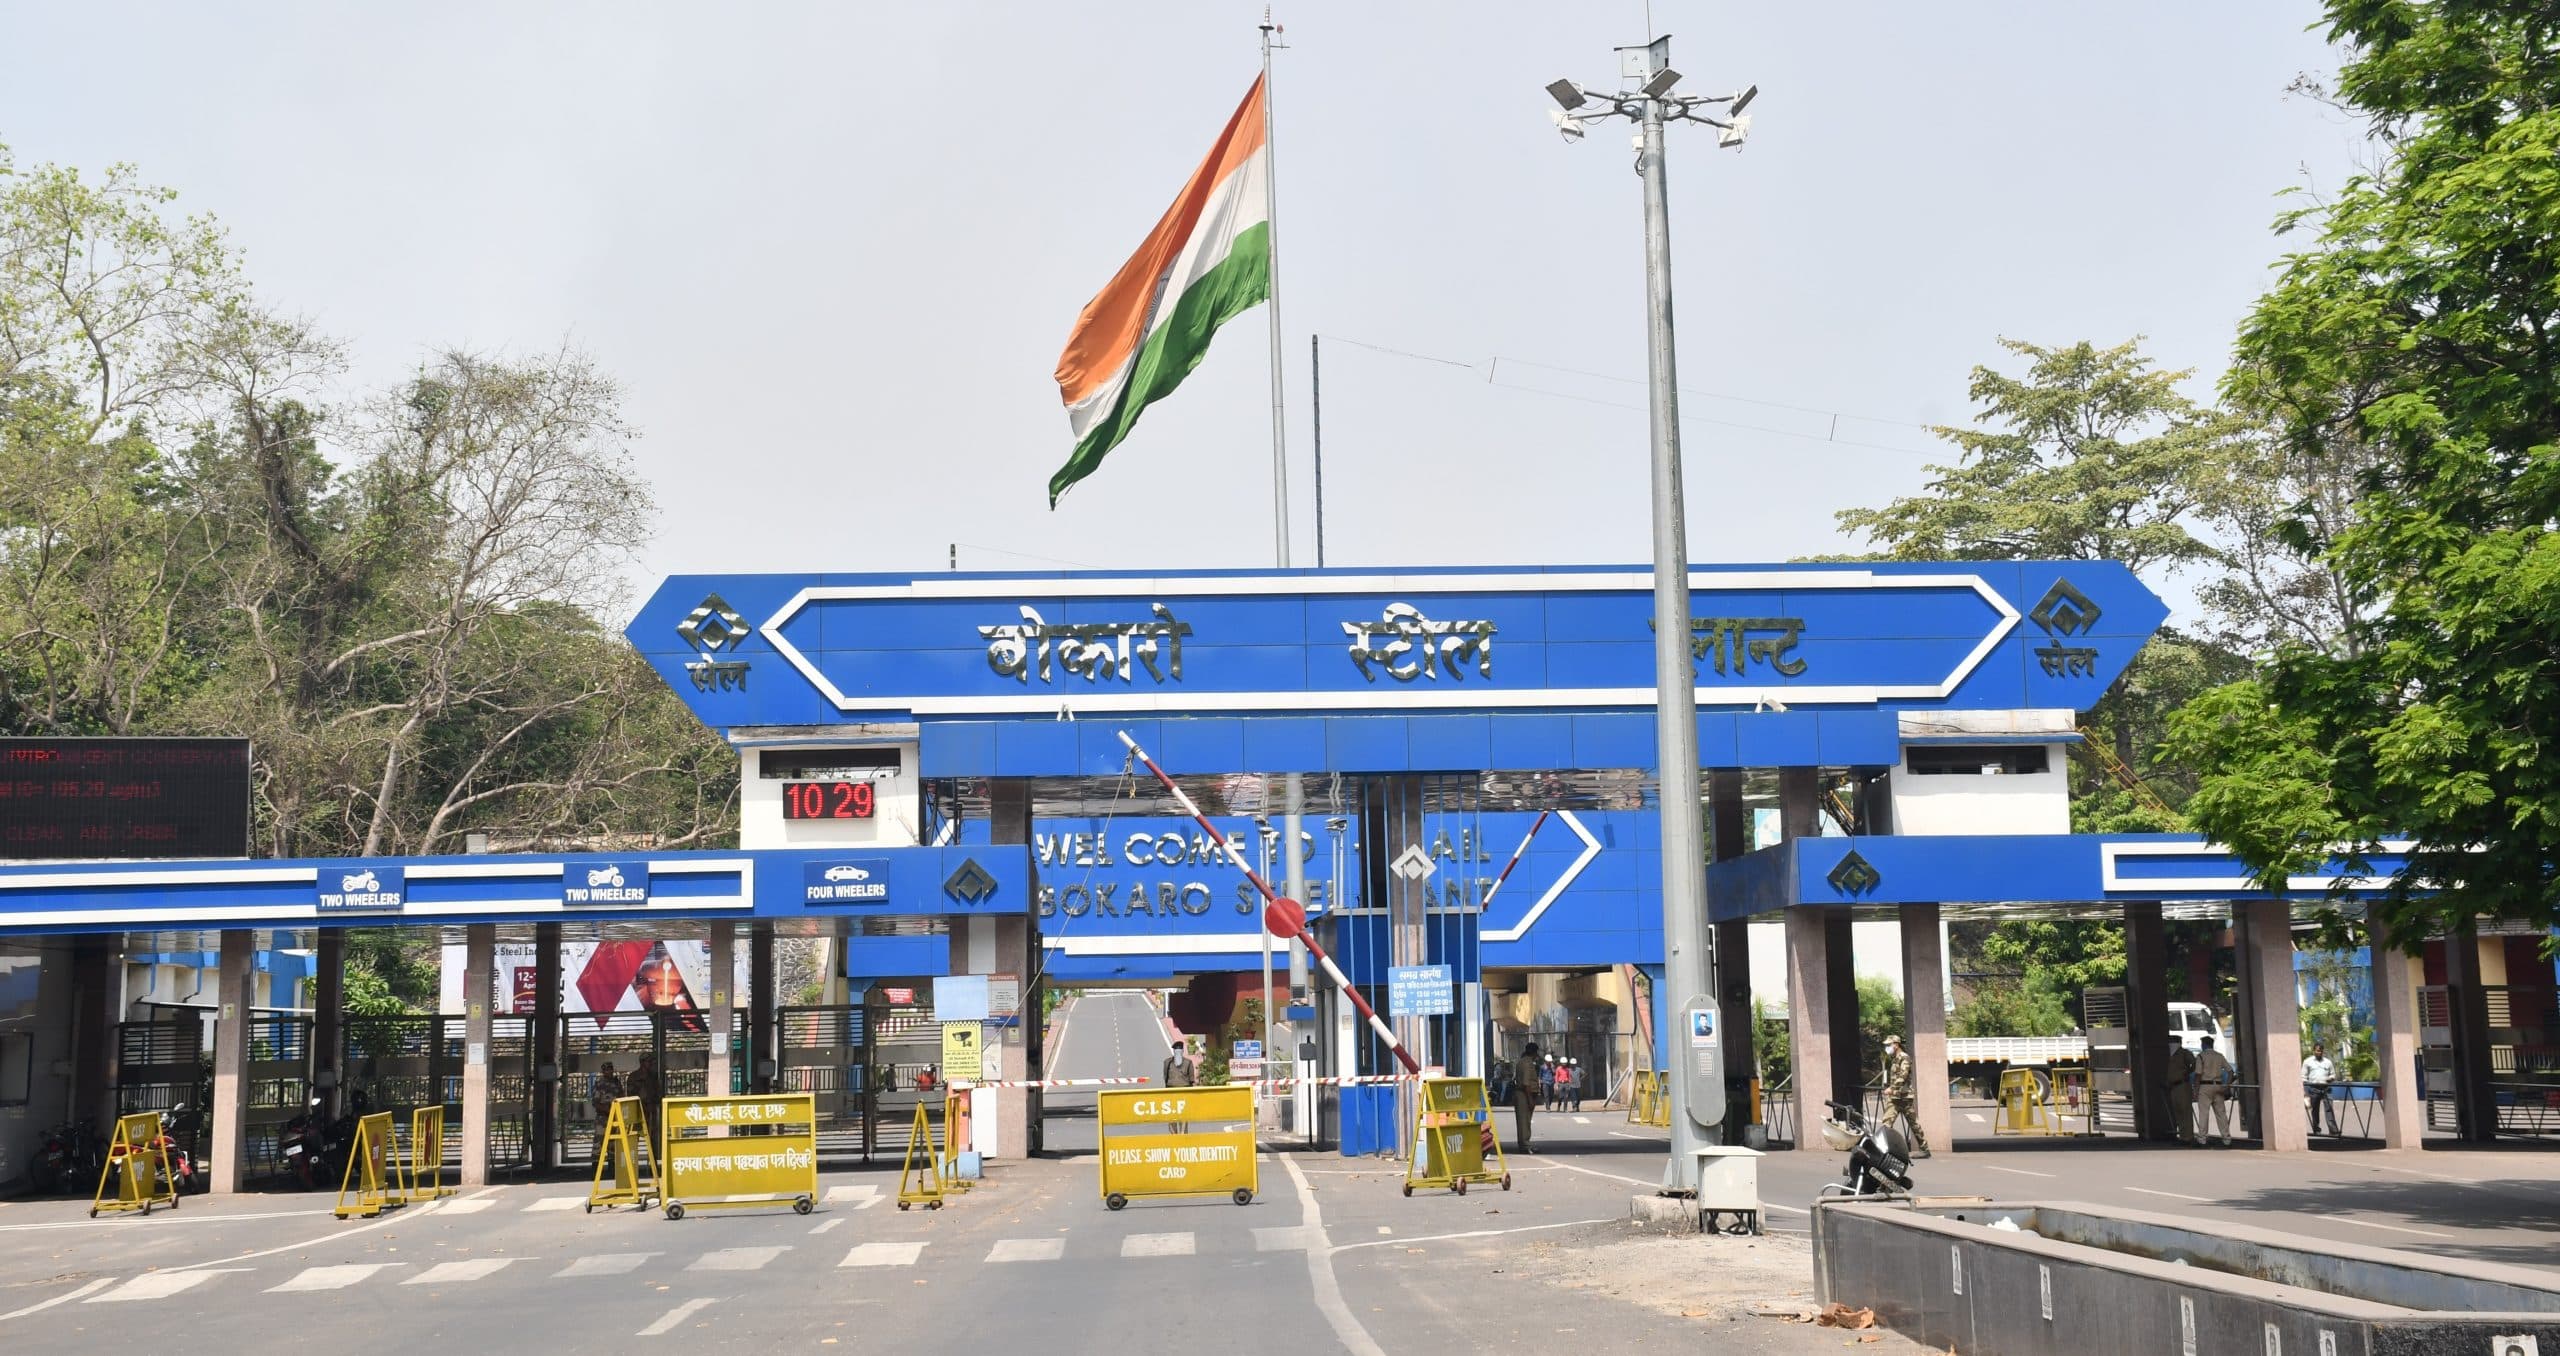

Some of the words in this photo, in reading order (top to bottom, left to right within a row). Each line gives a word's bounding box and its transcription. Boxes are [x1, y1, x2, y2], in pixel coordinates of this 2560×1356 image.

[977, 602, 1193, 686] बोकारो
[1340, 602, 1498, 683] स्टील
[1648, 617, 1807, 677] लान्ट
[2033, 638, 2099, 678] सेल
[684, 652, 752, 693] सेल
[787, 783, 824, 818] 10
[833, 782, 872, 818] 29
[1429, 828, 1490, 863] AIL
[320, 894, 343, 907] TWO
[345, 892, 400, 906] WHEELERS
[565, 888, 589, 901] TWO
[590, 888, 645, 901] WHEELERS
[807, 886, 833, 899] FOUR
[835, 884, 886, 898] WHEELERS
[1038, 881, 1212, 917] BOKARO
[500, 947, 522, 956] Steel
[1447, 1134, 1463, 1153] STOP
[1109, 1148, 1142, 1165] PLEASE
[1145, 1148, 1171, 1163] SHOW
[1174, 1147, 1199, 1162] YOUR
[1199, 1146, 1238, 1162] IDENTITY
[1159, 1167, 1187, 1178] CARD
